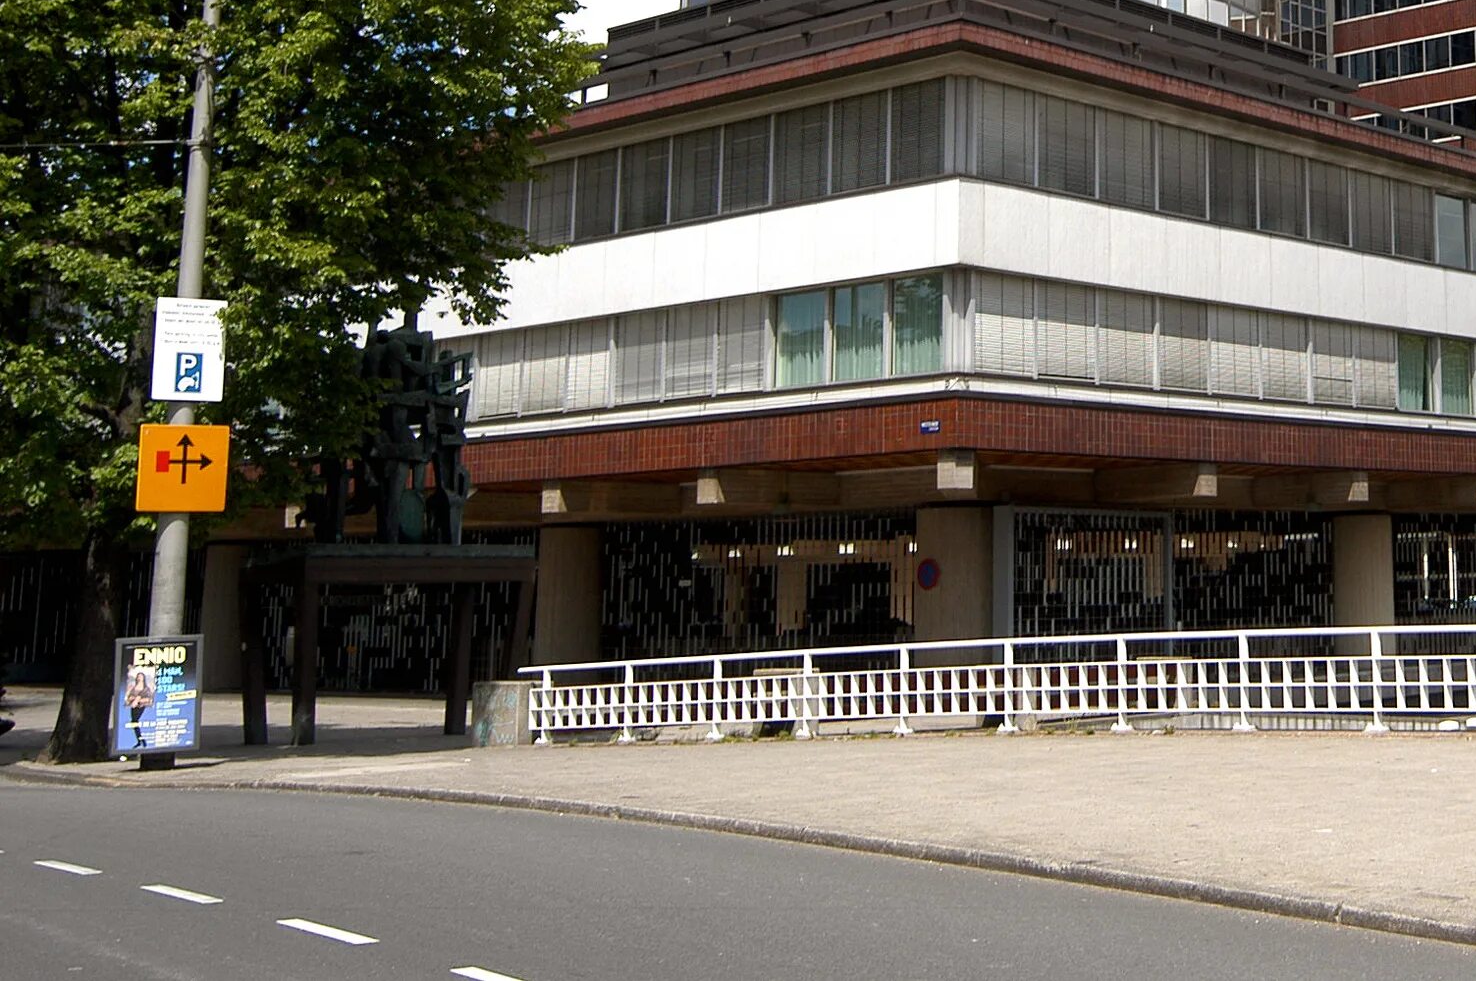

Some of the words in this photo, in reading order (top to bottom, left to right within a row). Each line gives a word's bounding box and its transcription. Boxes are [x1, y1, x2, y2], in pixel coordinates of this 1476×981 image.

[179, 354, 197, 376] P
[133, 646, 186, 665] ENNIO
[156, 676, 173, 684] 100
[156, 683, 185, 693] STARS!
